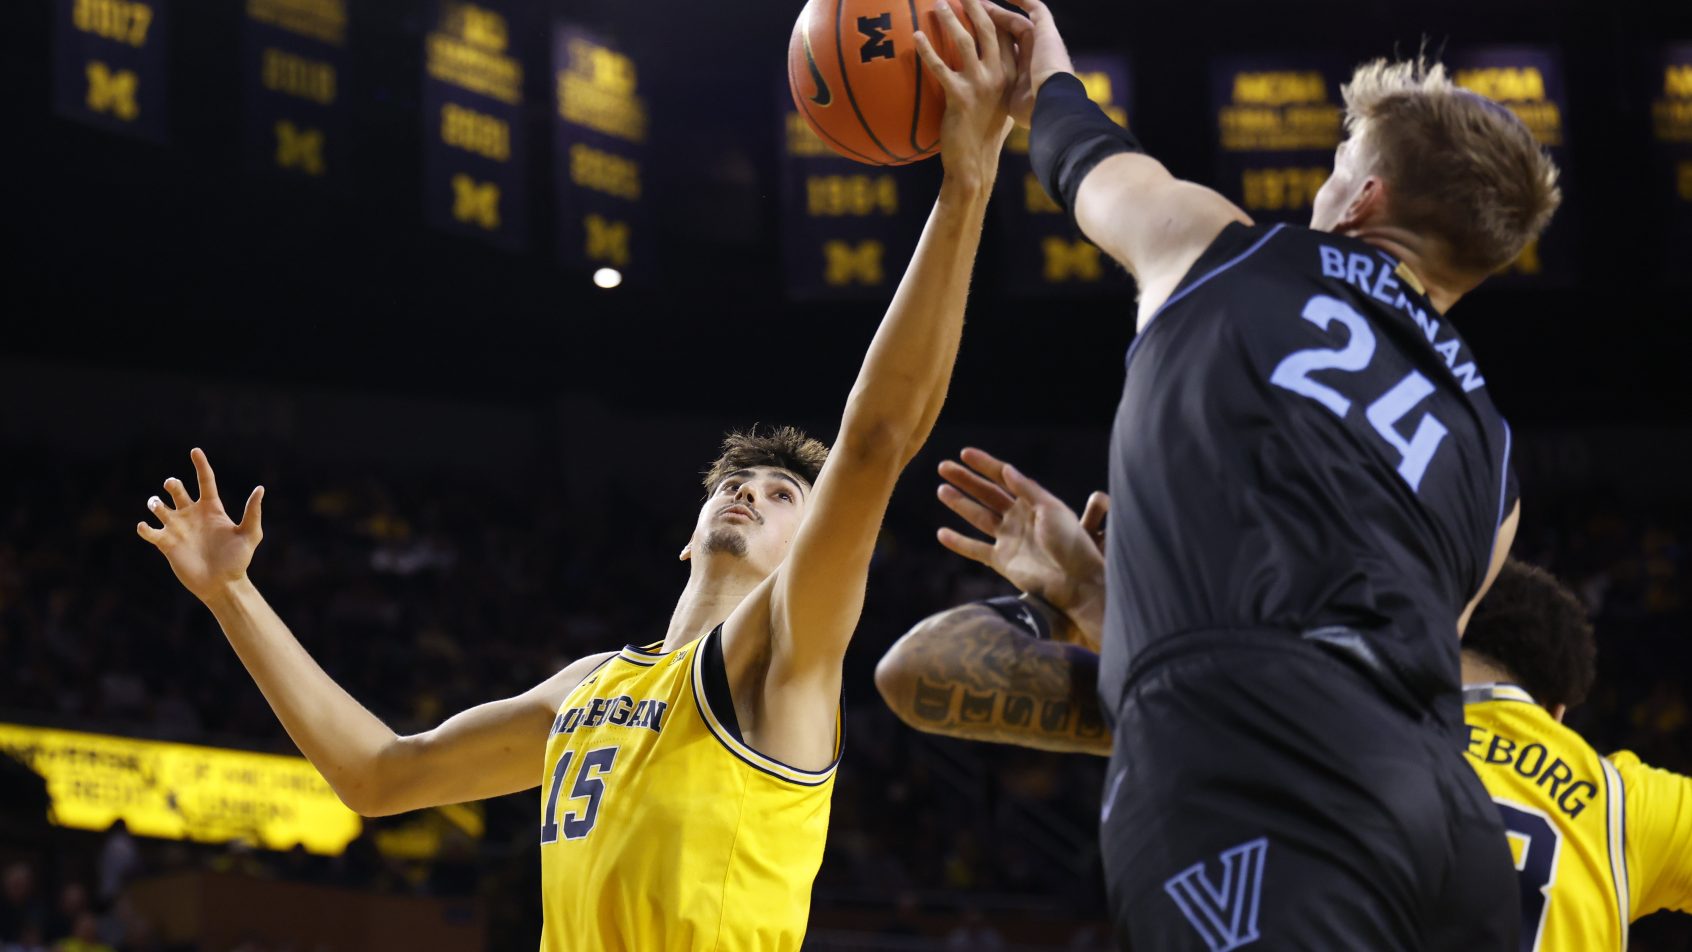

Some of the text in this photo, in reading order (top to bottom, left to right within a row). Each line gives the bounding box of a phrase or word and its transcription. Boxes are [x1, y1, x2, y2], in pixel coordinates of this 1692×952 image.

[857, 12, 895, 64] M
[1270, 295, 1448, 493] 24
[541, 746, 620, 846] 15
[1164, 837, 1268, 952] V
